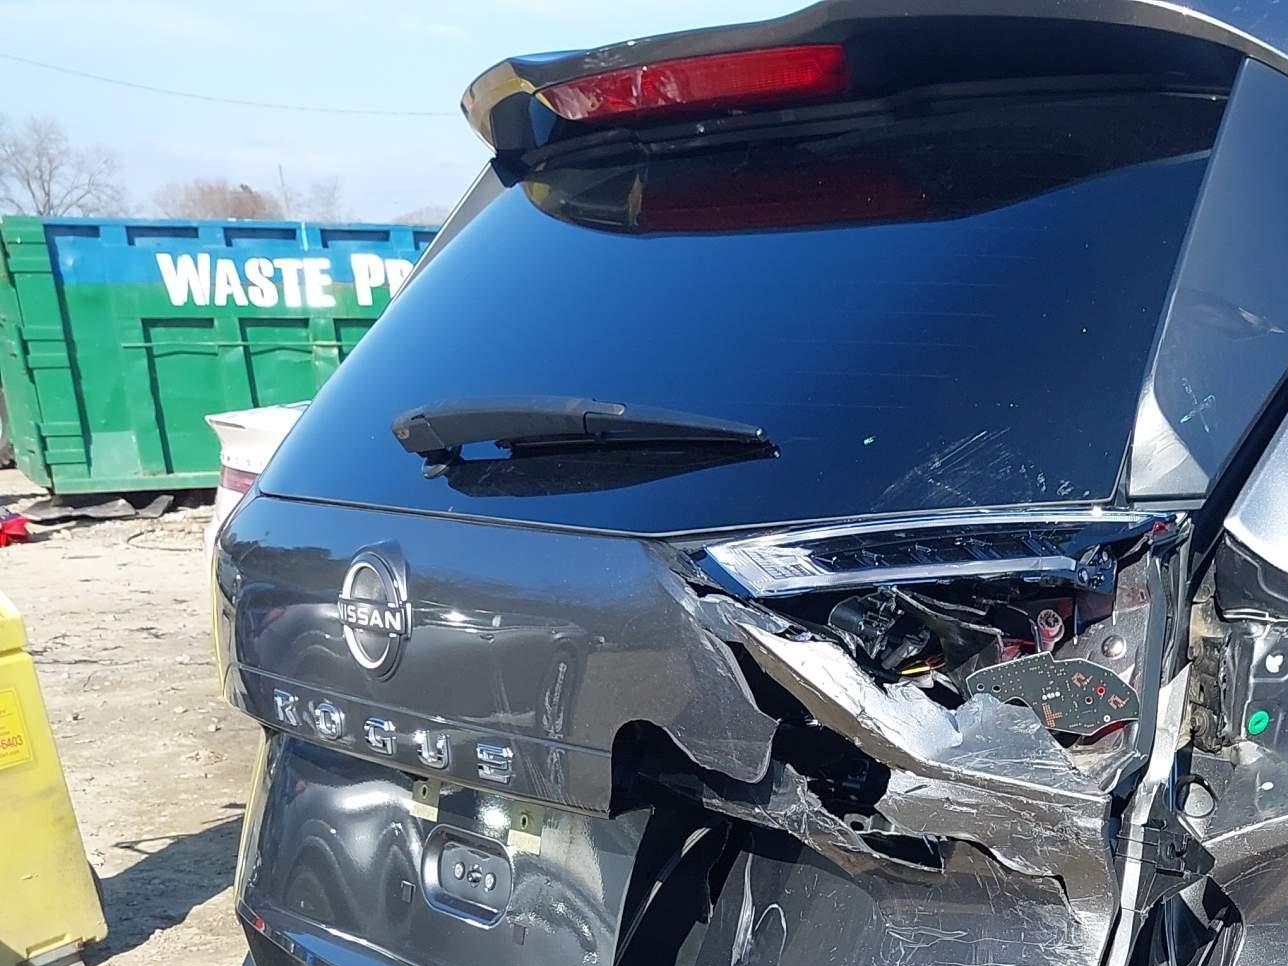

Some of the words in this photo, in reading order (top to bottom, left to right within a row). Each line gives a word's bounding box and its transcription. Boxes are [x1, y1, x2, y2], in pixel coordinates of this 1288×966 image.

[155, 252, 336, 308] WASTE
[337, 601, 401, 631] NISSAN
[273, 687, 515, 784] ROGUE
